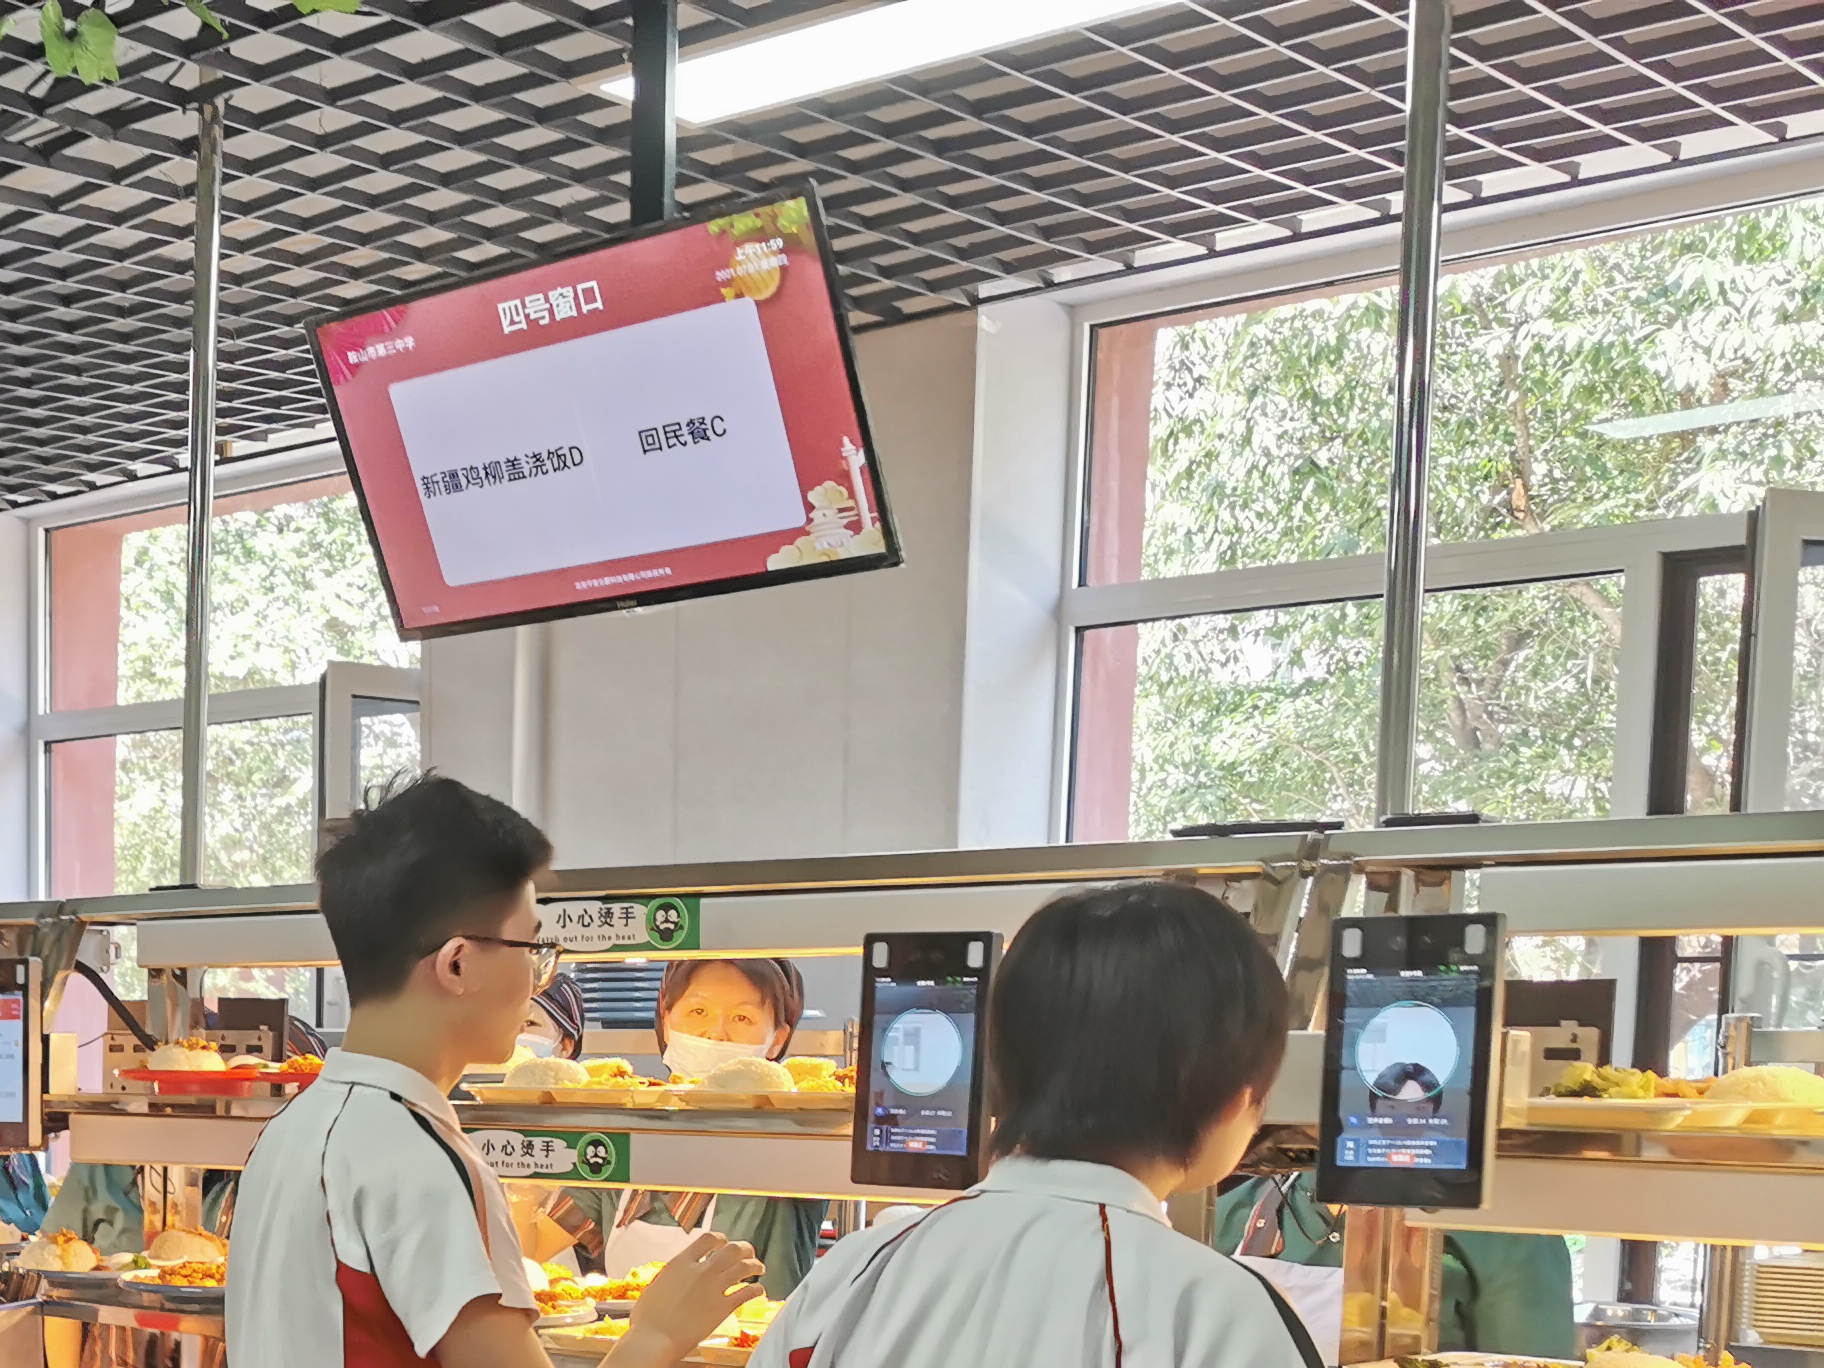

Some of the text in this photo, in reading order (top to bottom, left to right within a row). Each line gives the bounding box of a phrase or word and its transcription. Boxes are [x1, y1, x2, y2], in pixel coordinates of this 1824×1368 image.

[496, 280, 605, 335] 四号窗口
[420, 415, 728, 499] 新疆鸡柳盖浇饭D 回民餐C
[555, 905, 637, 929] 小心烫手
[562, 933, 578, 943] out
[580, 932, 594, 942] for
[597, 931, 612, 941] the
[615, 932, 636, 941] heat
[481, 1138, 556, 1158] 小心烫手
[501, 1159, 514, 1169] for
[516, 1160, 531, 1169] the
[534, 1161, 554, 1170] heat
